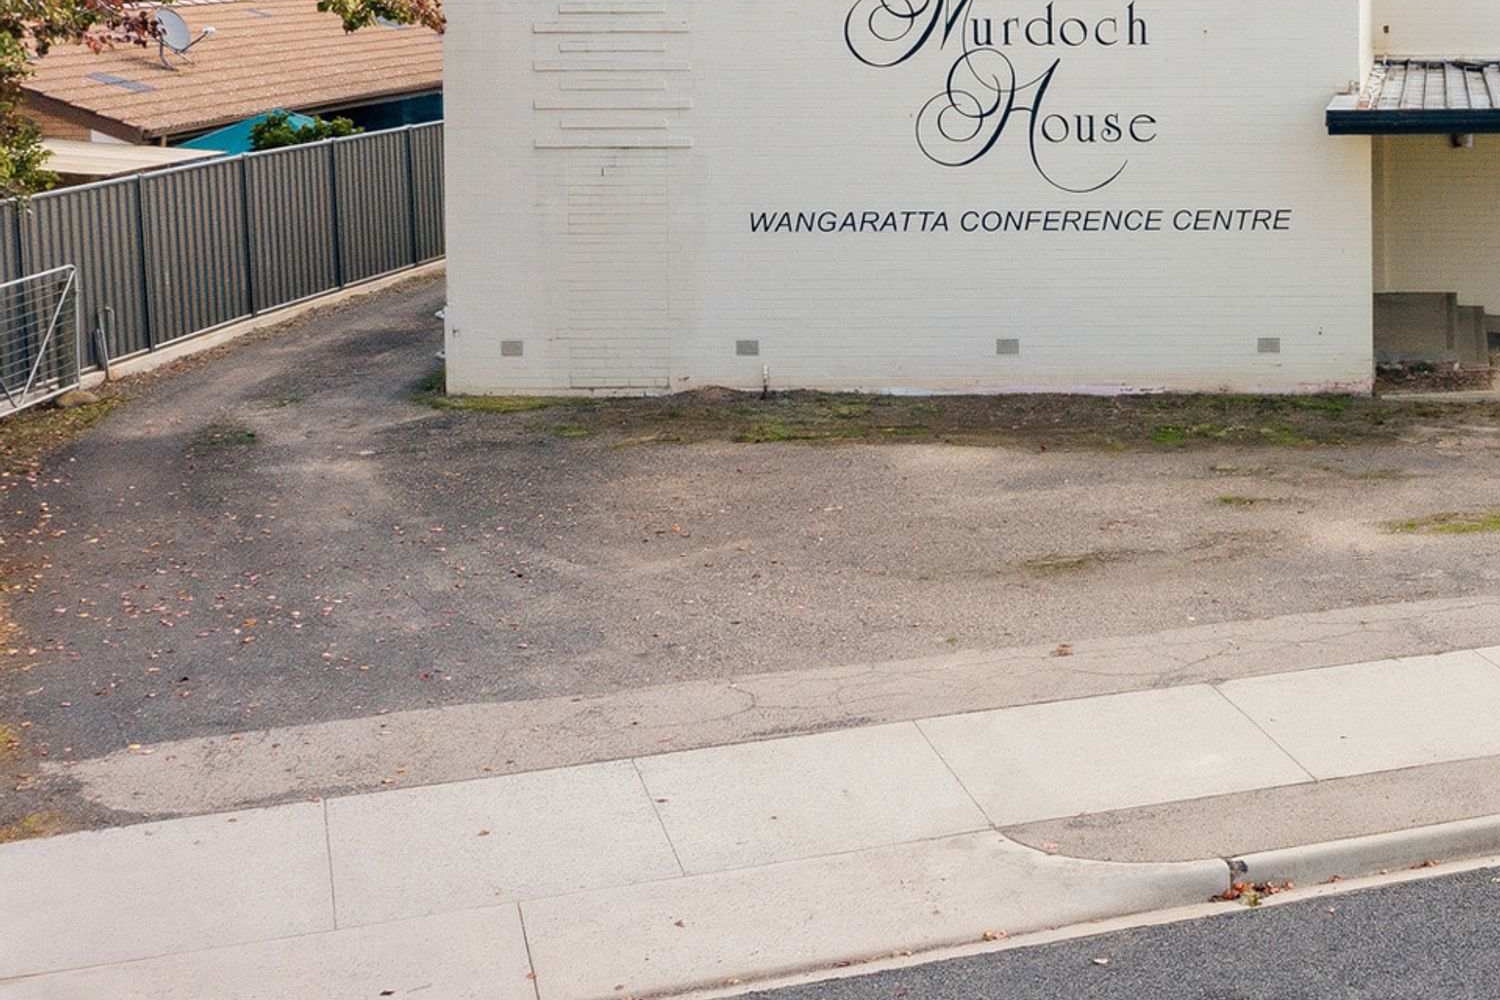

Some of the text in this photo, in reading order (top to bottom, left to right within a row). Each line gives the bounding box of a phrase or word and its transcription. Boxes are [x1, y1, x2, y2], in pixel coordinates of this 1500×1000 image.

[915, 47, 1157, 192] House
[749, 208, 1292, 232] WANGARATTA CONFERENCE CENTRE
